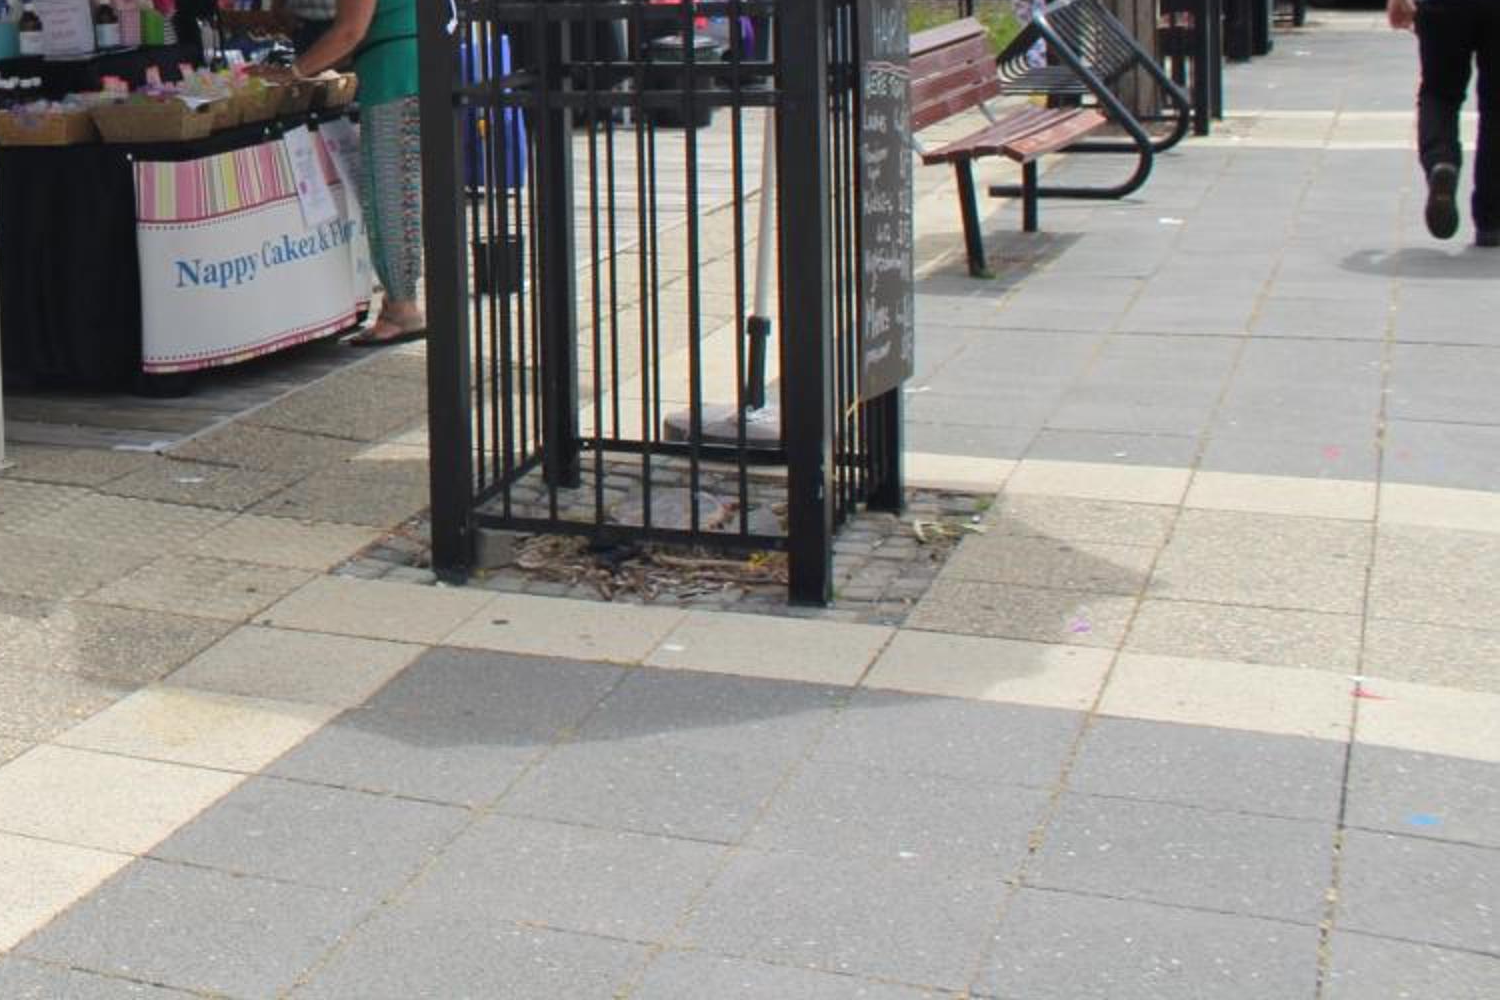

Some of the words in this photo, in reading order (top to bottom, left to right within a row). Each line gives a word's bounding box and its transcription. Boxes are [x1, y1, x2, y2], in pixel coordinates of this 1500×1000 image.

[174, 251, 258, 289] Nappy
[261, 233, 315, 268] Cakez
[315, 228, 329, 251] &
